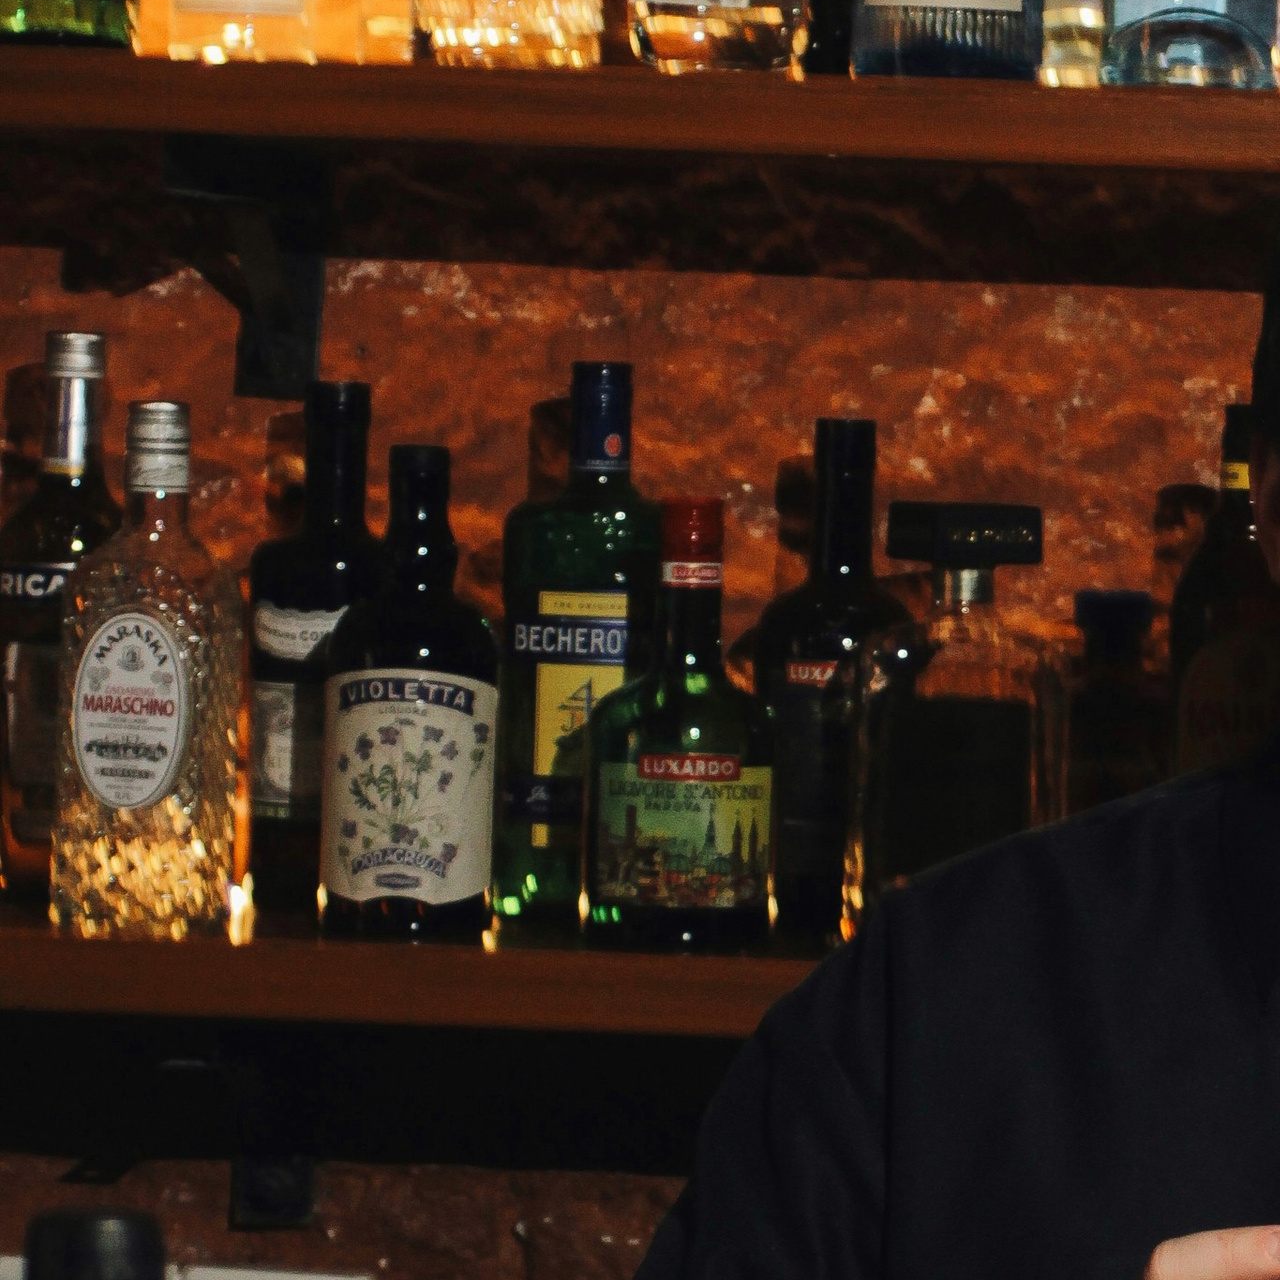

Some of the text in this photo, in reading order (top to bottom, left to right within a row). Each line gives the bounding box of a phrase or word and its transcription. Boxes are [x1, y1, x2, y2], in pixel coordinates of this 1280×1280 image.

[95, 624, 168, 668] MARASKA
[82, 693, 175, 718] MARASCHINO
[346, 681, 456, 708] VIOLETTA
[643, 758, 735, 776] LUXARDO
